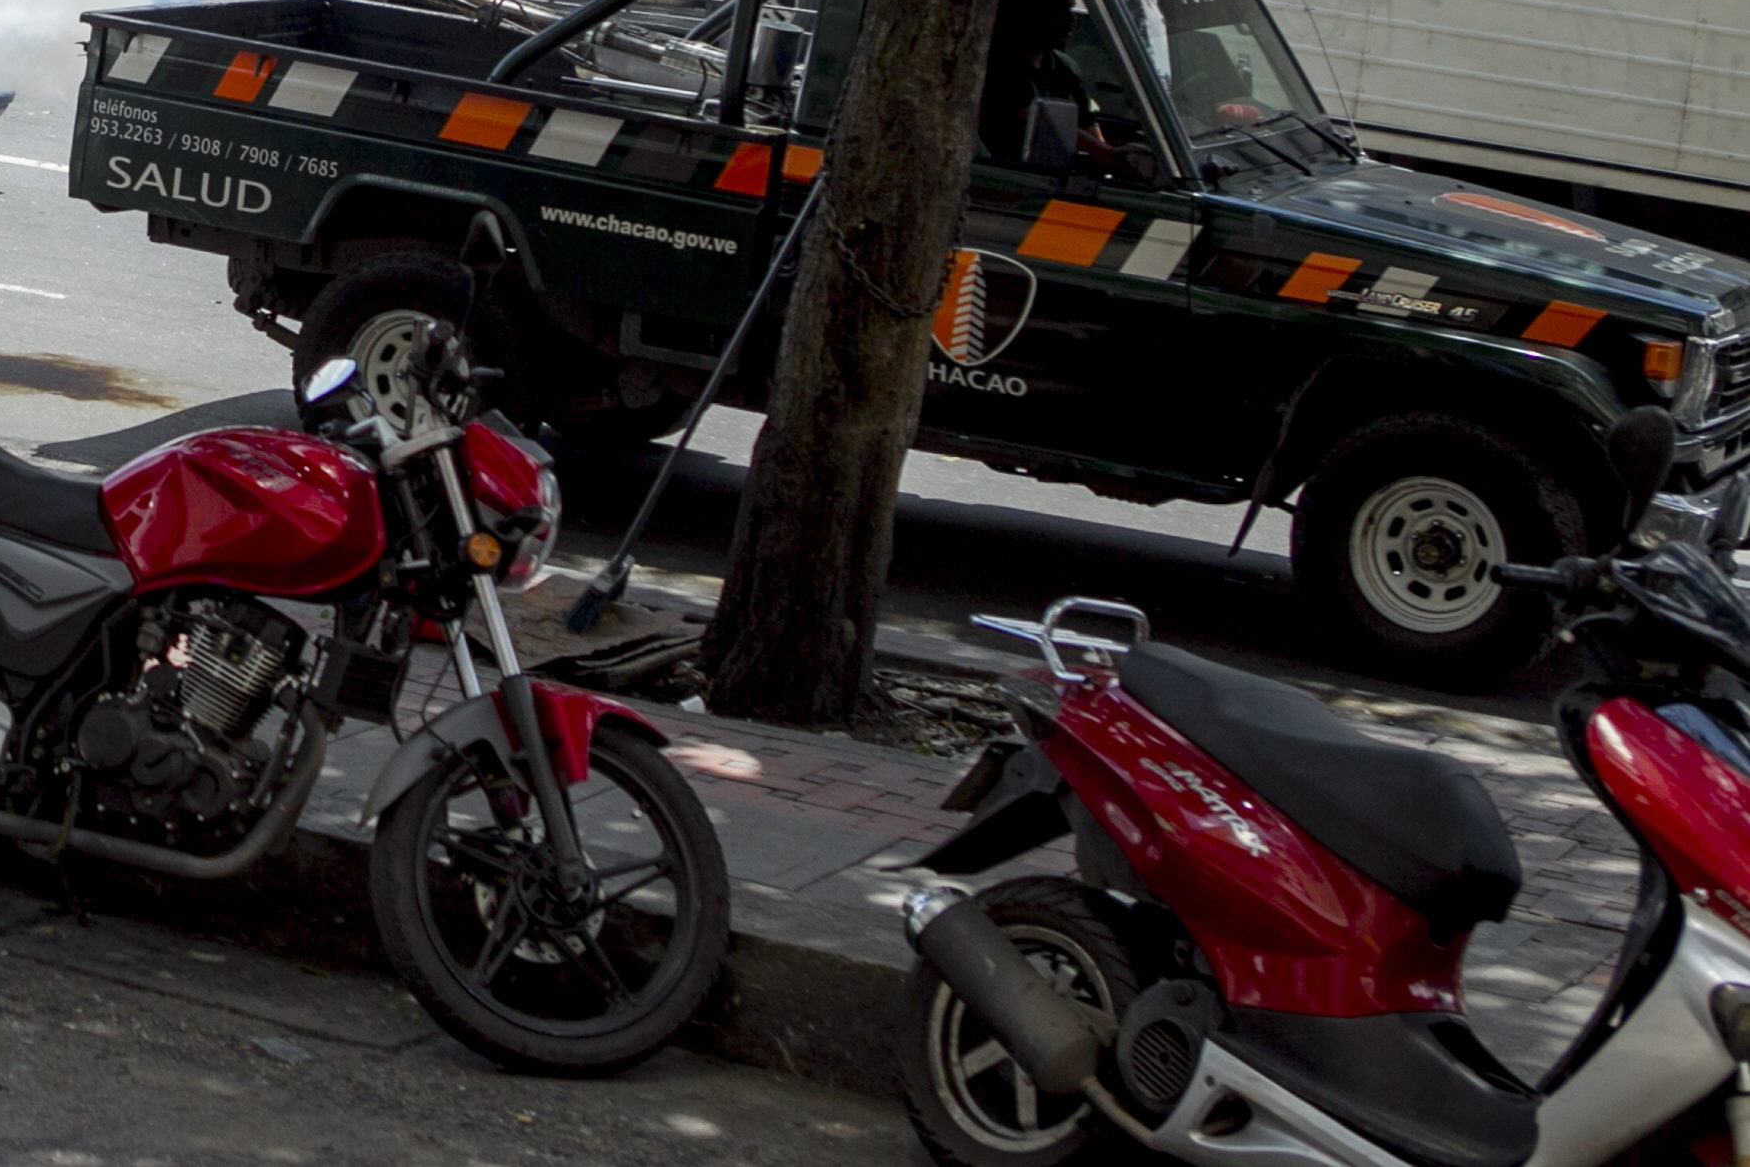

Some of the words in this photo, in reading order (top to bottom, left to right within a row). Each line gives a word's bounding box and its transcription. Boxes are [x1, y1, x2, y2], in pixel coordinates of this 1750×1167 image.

[93, 98, 158, 124] teléfonos
[90, 117, 163, 146] 953.2263
[181, 133, 221, 157] 9308
[239, 144, 280, 168] 7908
[297, 155, 338, 179] 7685
[105, 154, 273, 214] SALUD
[540, 205, 738, 255] www.chacao.gov.ve
[1392, 292, 1444, 316] CRUISER
[927, 360, 1029, 397] HACAO
